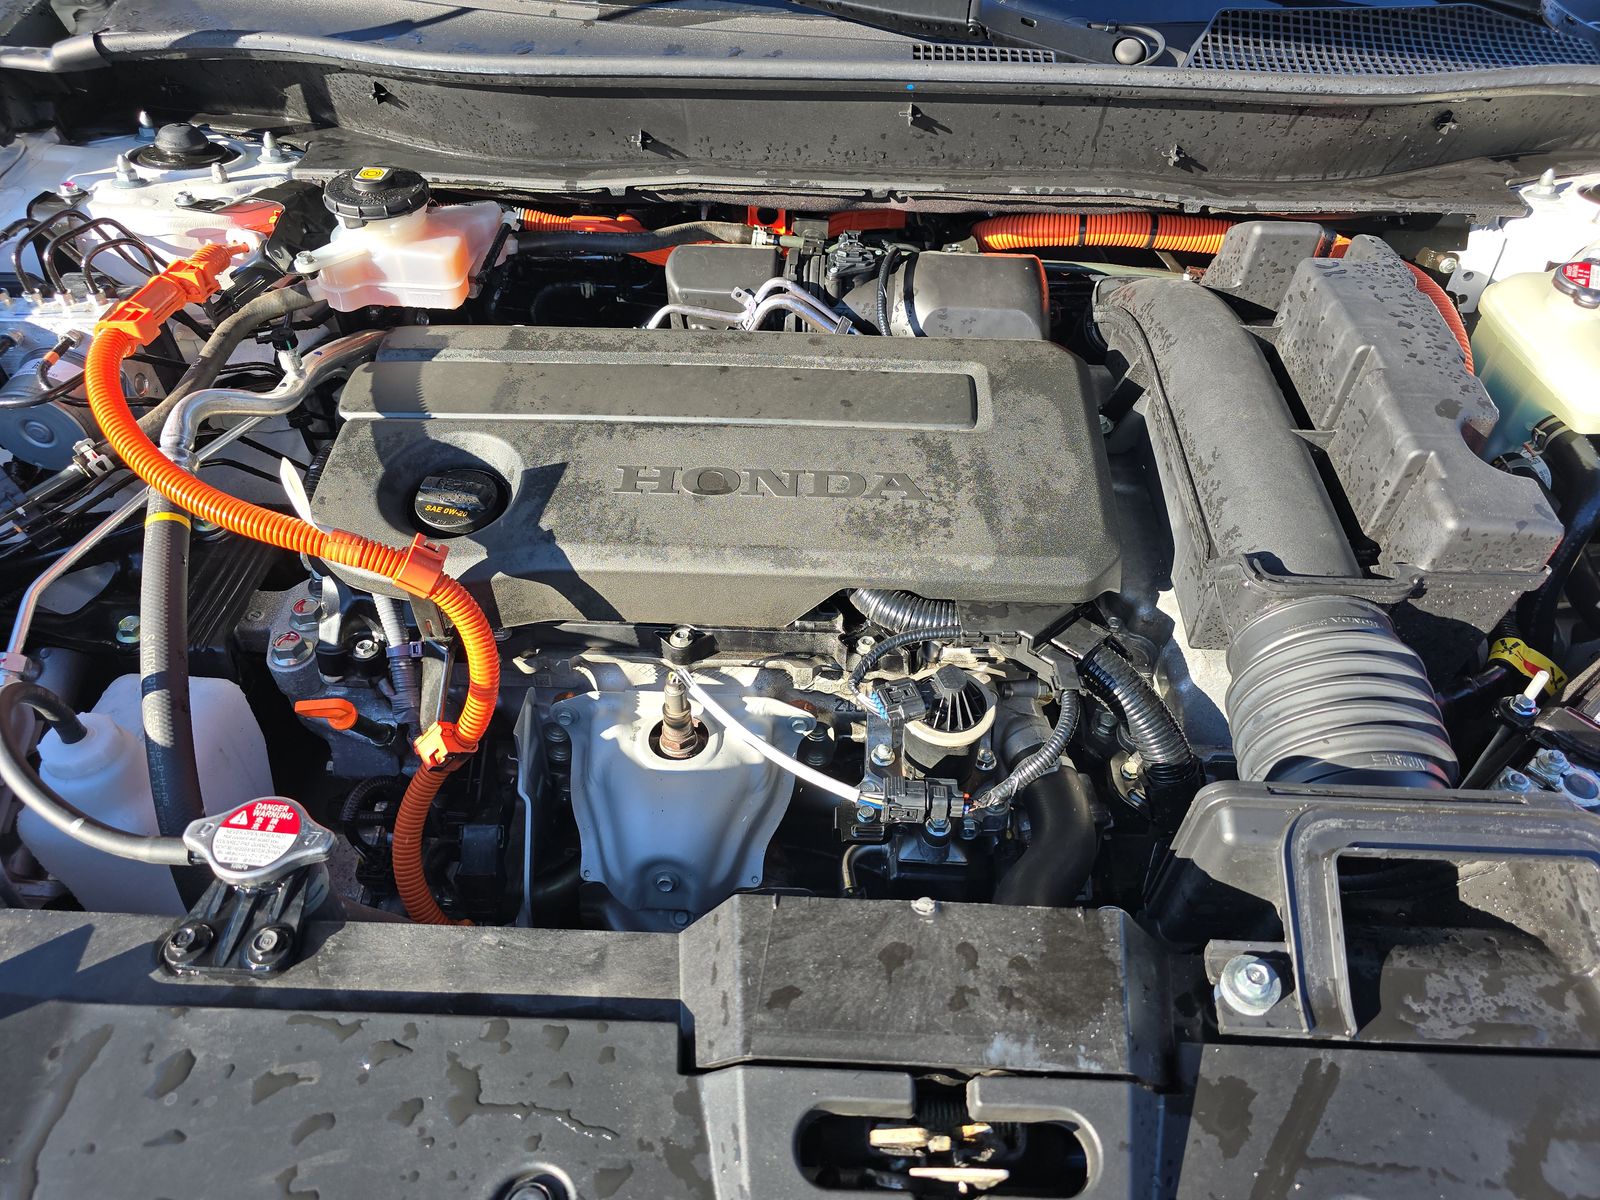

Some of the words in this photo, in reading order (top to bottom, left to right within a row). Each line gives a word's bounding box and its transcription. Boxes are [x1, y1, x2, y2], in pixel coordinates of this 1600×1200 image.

[611, 465, 932, 500] HONDA
[424, 504, 443, 513] SAE
[443, 507, 468, 517] 0W-20
[255, 803, 290, 812] DANGER
[252, 808, 294, 820] WARNUNG
